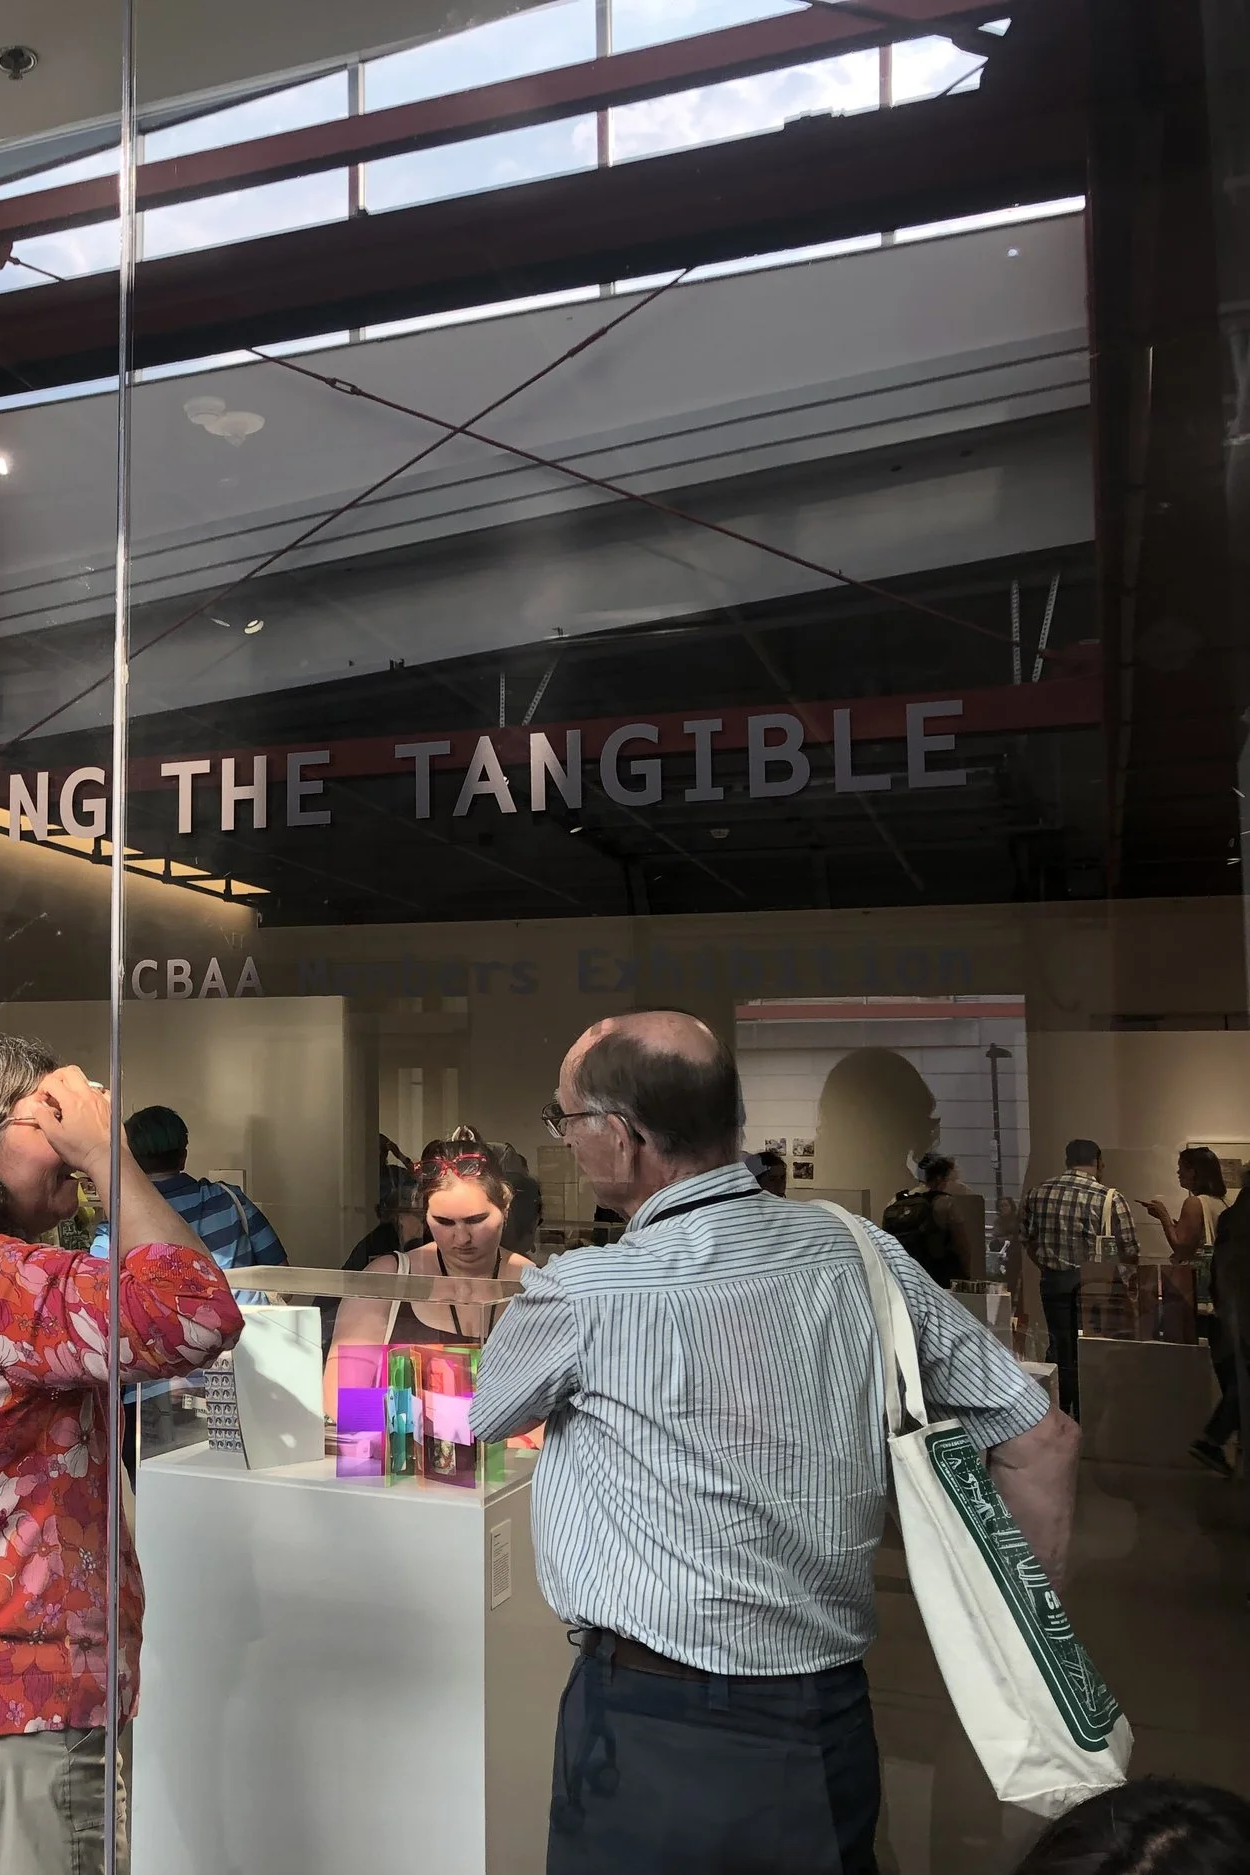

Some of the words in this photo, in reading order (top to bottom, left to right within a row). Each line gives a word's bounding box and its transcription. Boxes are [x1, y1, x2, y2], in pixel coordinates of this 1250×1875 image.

[161, 750, 331, 834] THE
[395, 700, 967, 819] TANGIBLE
[132, 956, 264, 1000] CBAA
[579, 941, 972, 992] Exhibition
